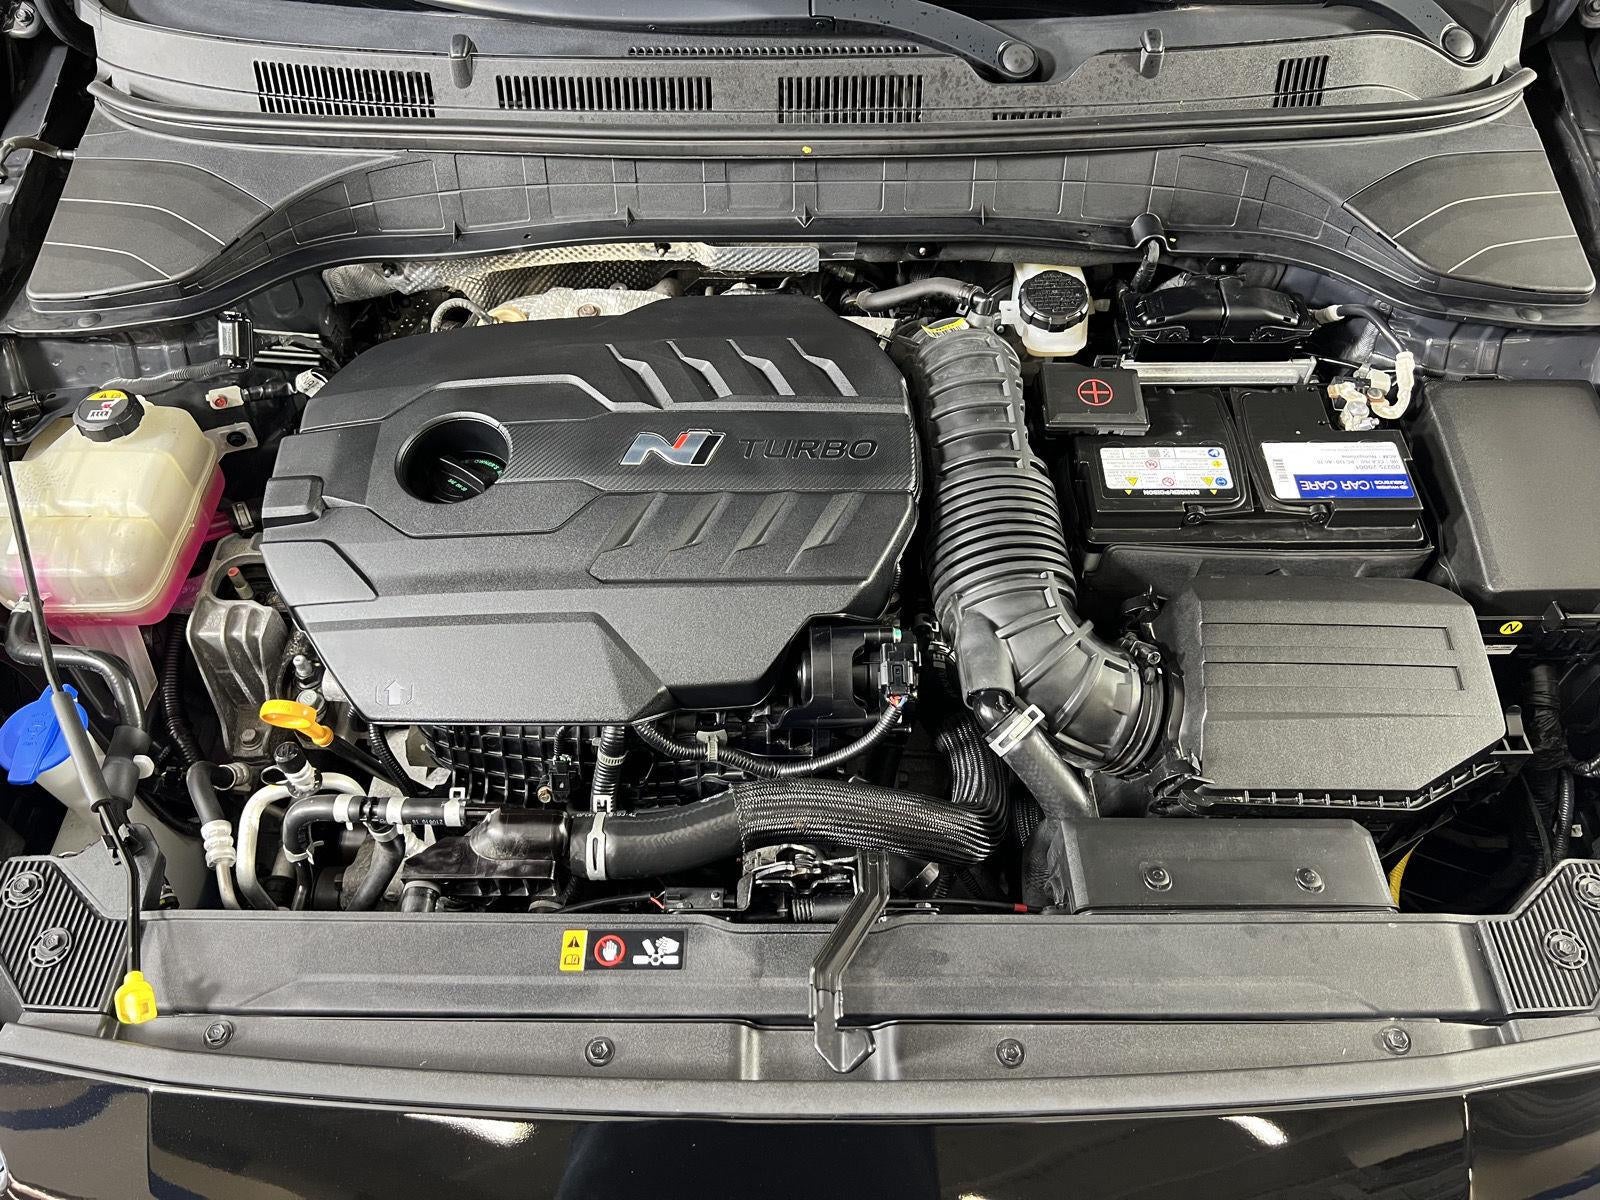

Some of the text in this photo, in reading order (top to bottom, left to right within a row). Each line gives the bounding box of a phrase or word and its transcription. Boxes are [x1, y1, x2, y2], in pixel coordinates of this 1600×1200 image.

[739, 438, 878, 461] TURBO
[1299, 479, 1369, 491] CAR CARE
